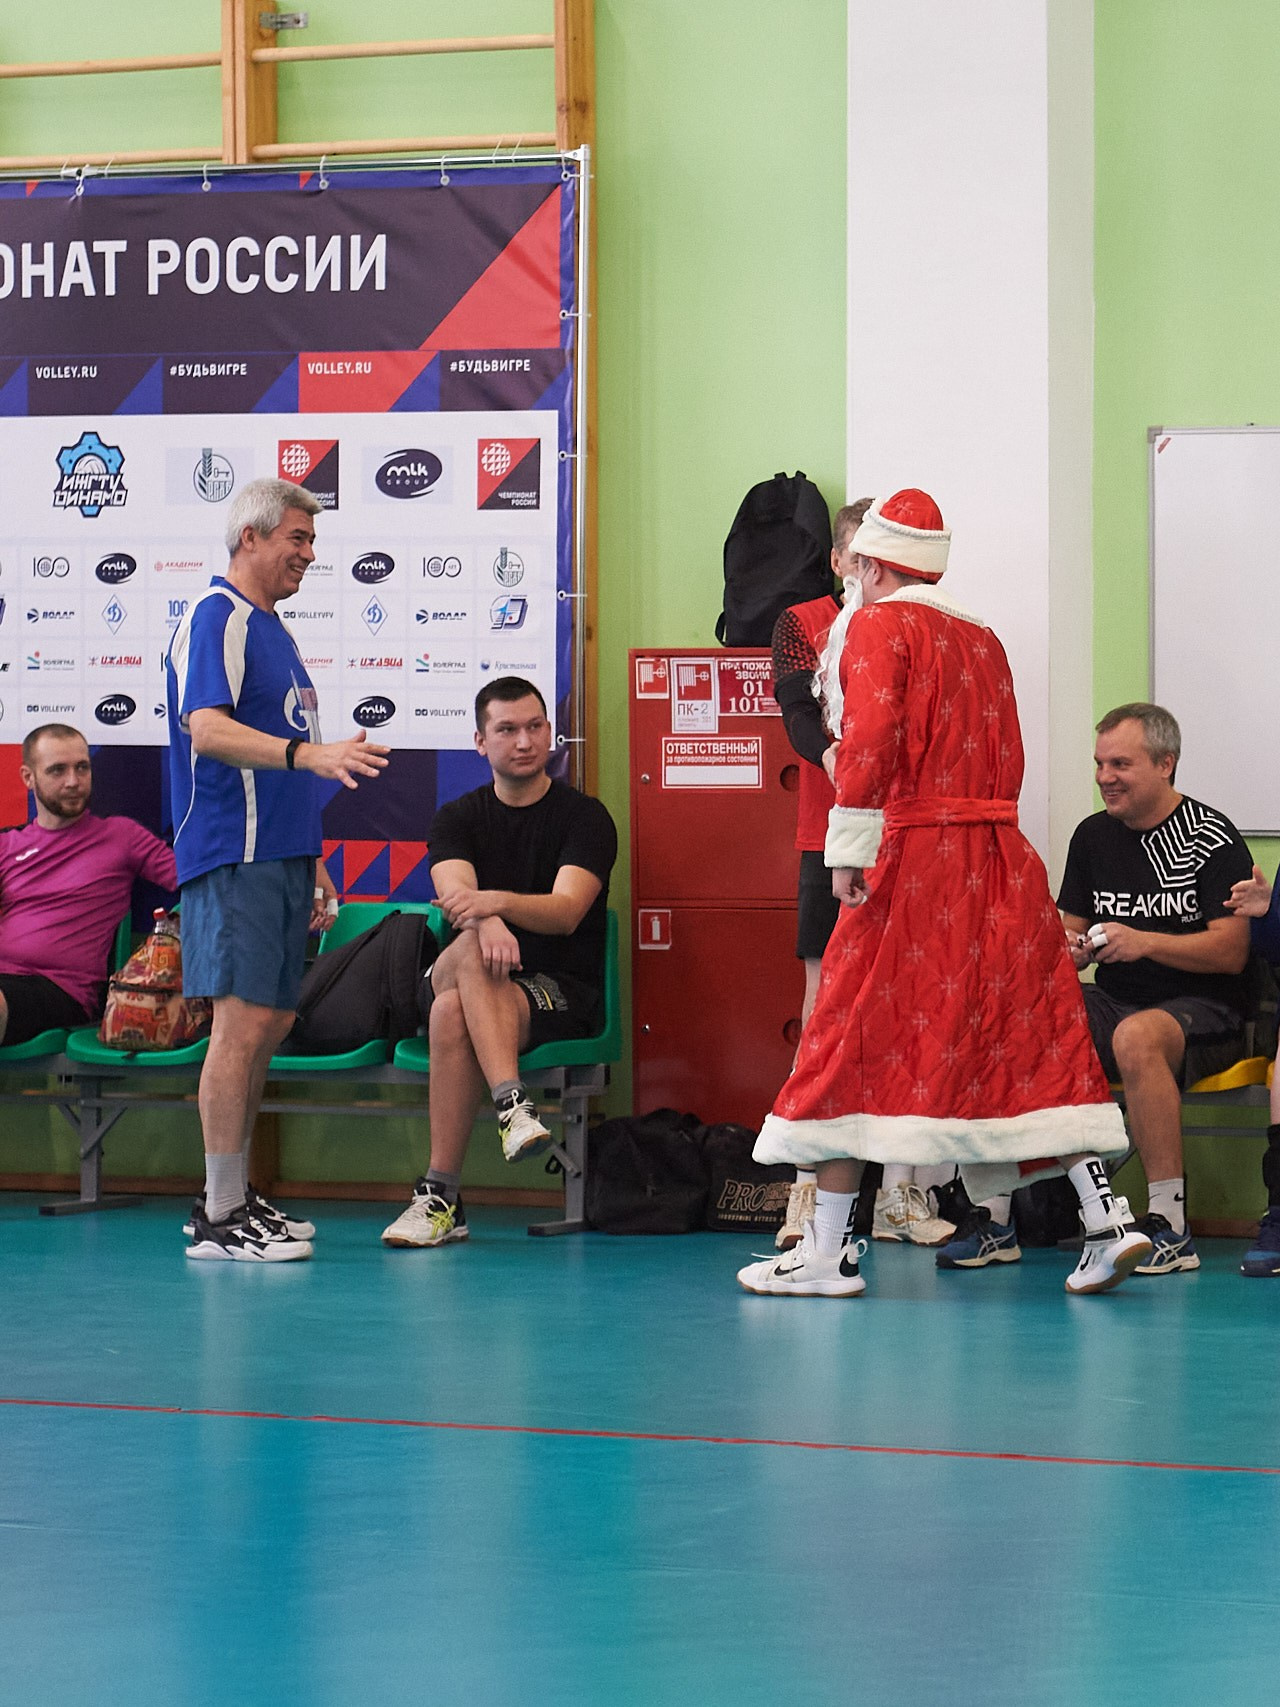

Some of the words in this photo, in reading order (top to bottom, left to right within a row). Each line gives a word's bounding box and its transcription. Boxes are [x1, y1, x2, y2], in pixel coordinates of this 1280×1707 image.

[147, 233, 387, 296] РОССИИ
[35, 366, 98, 379] VOLLEY.RU
[169, 363, 248, 378] #БУДЬВИГРЕ
[306, 361, 373, 376] VOLLEY.RU
[449, 358, 531, 374] #БУДЬВИГРЕ
[386, 462, 428, 477] mlk
[61, 474, 121, 494] ИЖГТУ
[498, 491, 537, 499] ЧЕМПИОНАТ
[359, 561, 386, 570] mlk
[297, 611, 334, 619] VOLLEYVFV
[743, 662, 772, 671] ПОЖА
[742, 681, 765, 696] 01
[360, 704, 387, 714] mlk
[729, 697, 761, 713] 101
[429, 709, 467, 717] VOLLEYVFV
[666, 740, 758, 755] ОТВЕТСТВЕННЫЙ
[673, 756, 726, 765] противопожарное
[1093, 889, 1199, 918] BREAKING
